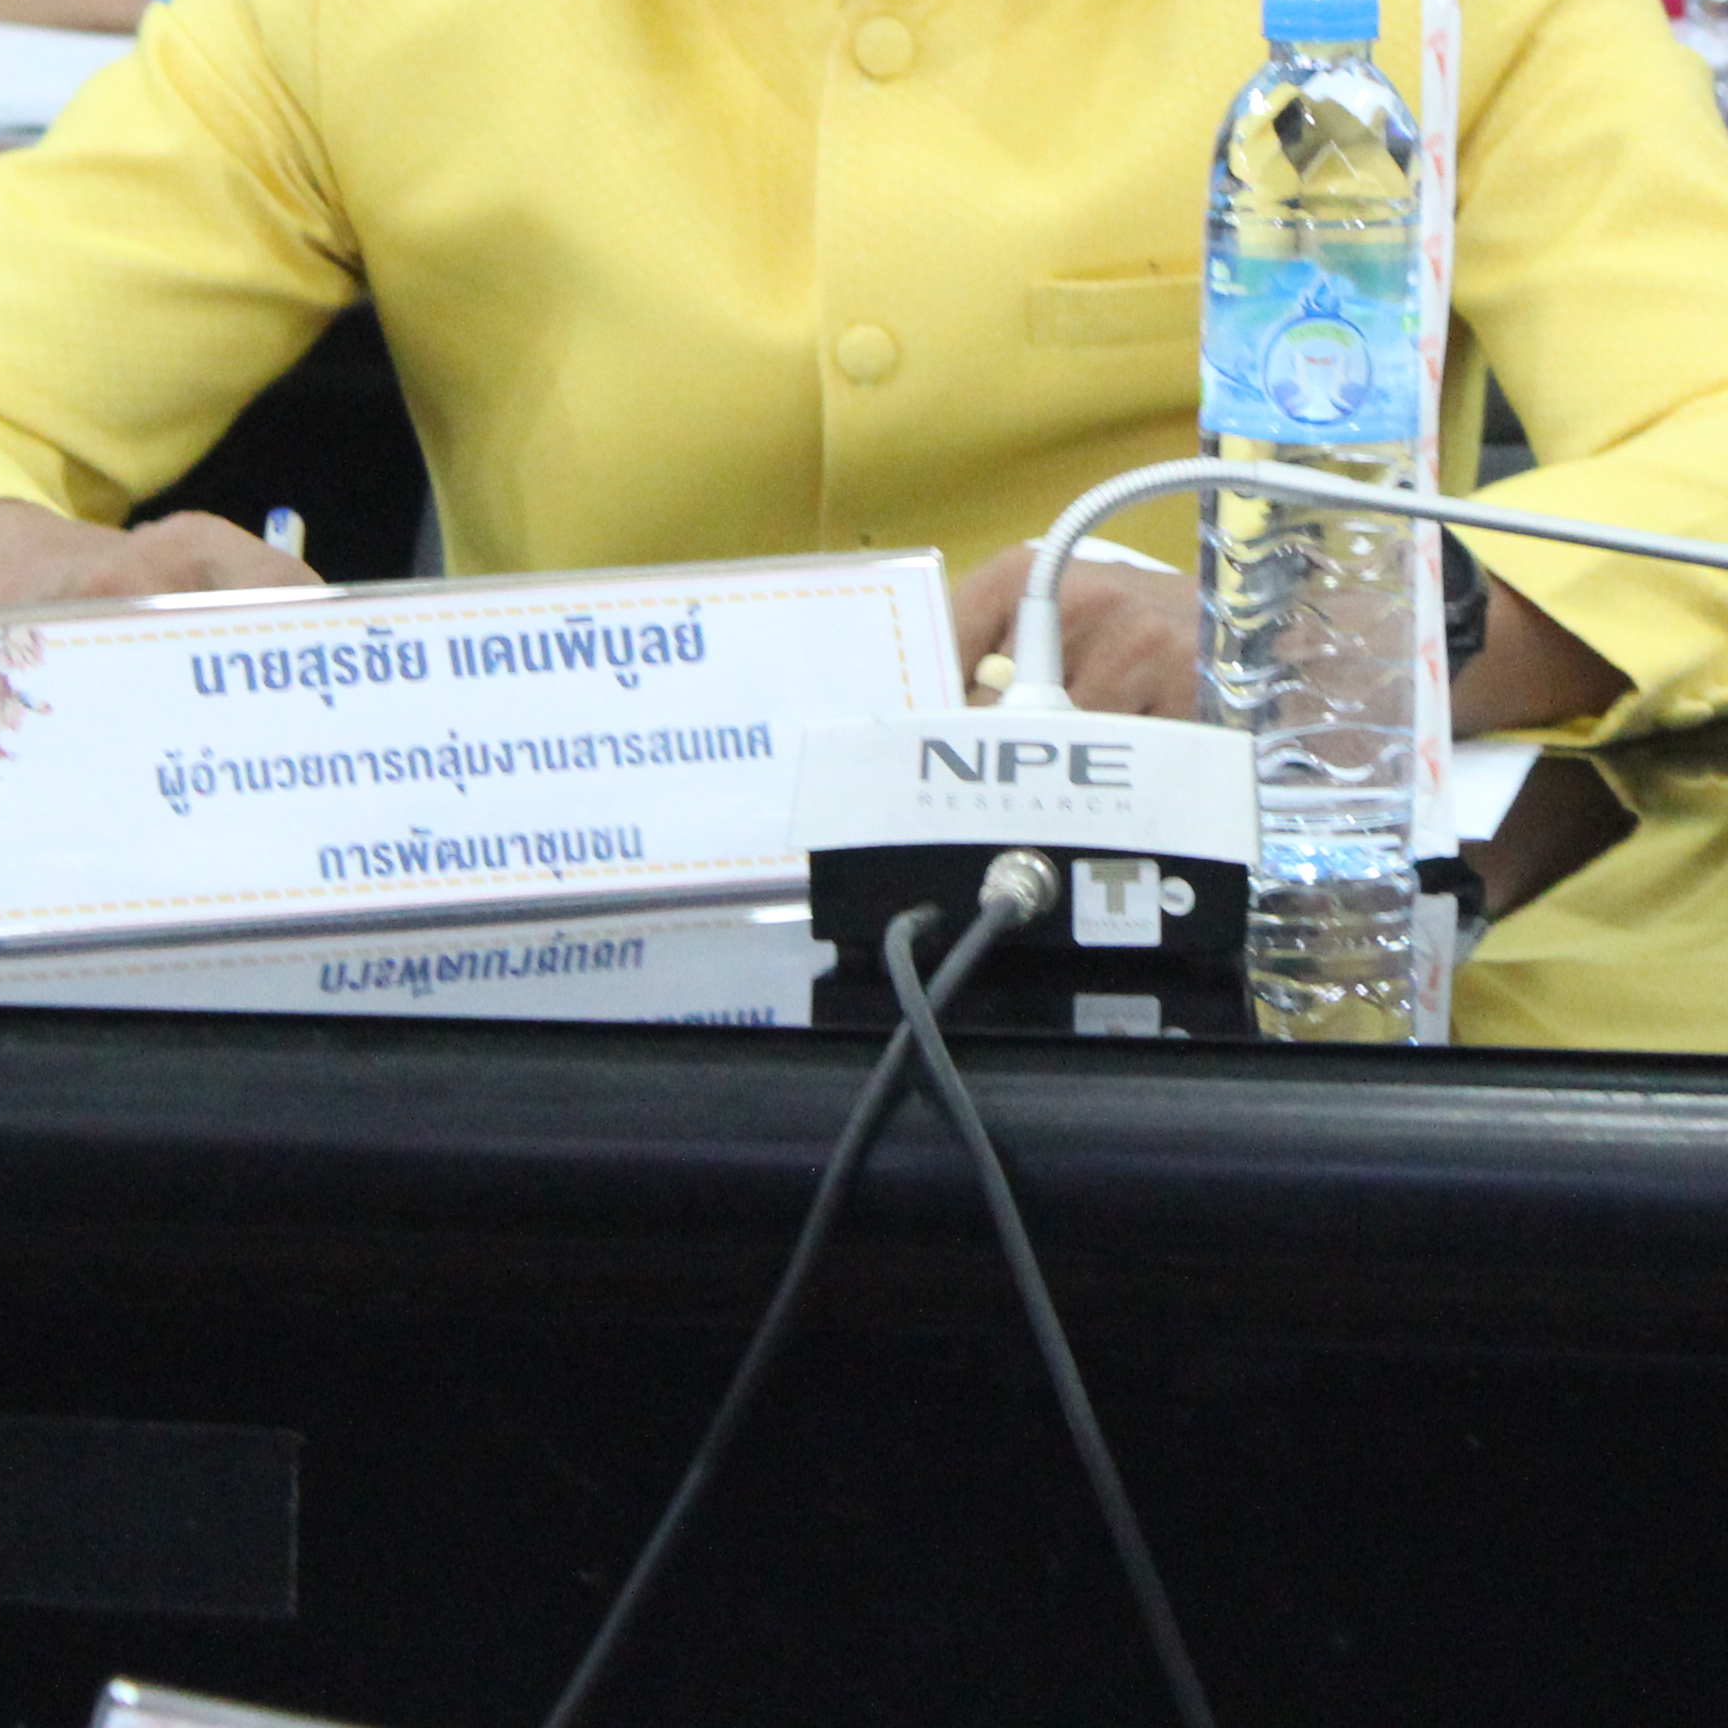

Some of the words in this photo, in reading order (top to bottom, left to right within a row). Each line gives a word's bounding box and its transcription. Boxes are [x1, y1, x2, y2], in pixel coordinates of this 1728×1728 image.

[189, 624, 429, 709] นายสุรชัย
[155, 720, 775, 816] ผู้อำนวยการกลุ่มงานสารสนเทศ
[919, 737, 1135, 787] NPE
[915, 790, 1135, 815] RESEARCH
[318, 823, 645, 882] การพัฒนาชุมชน
